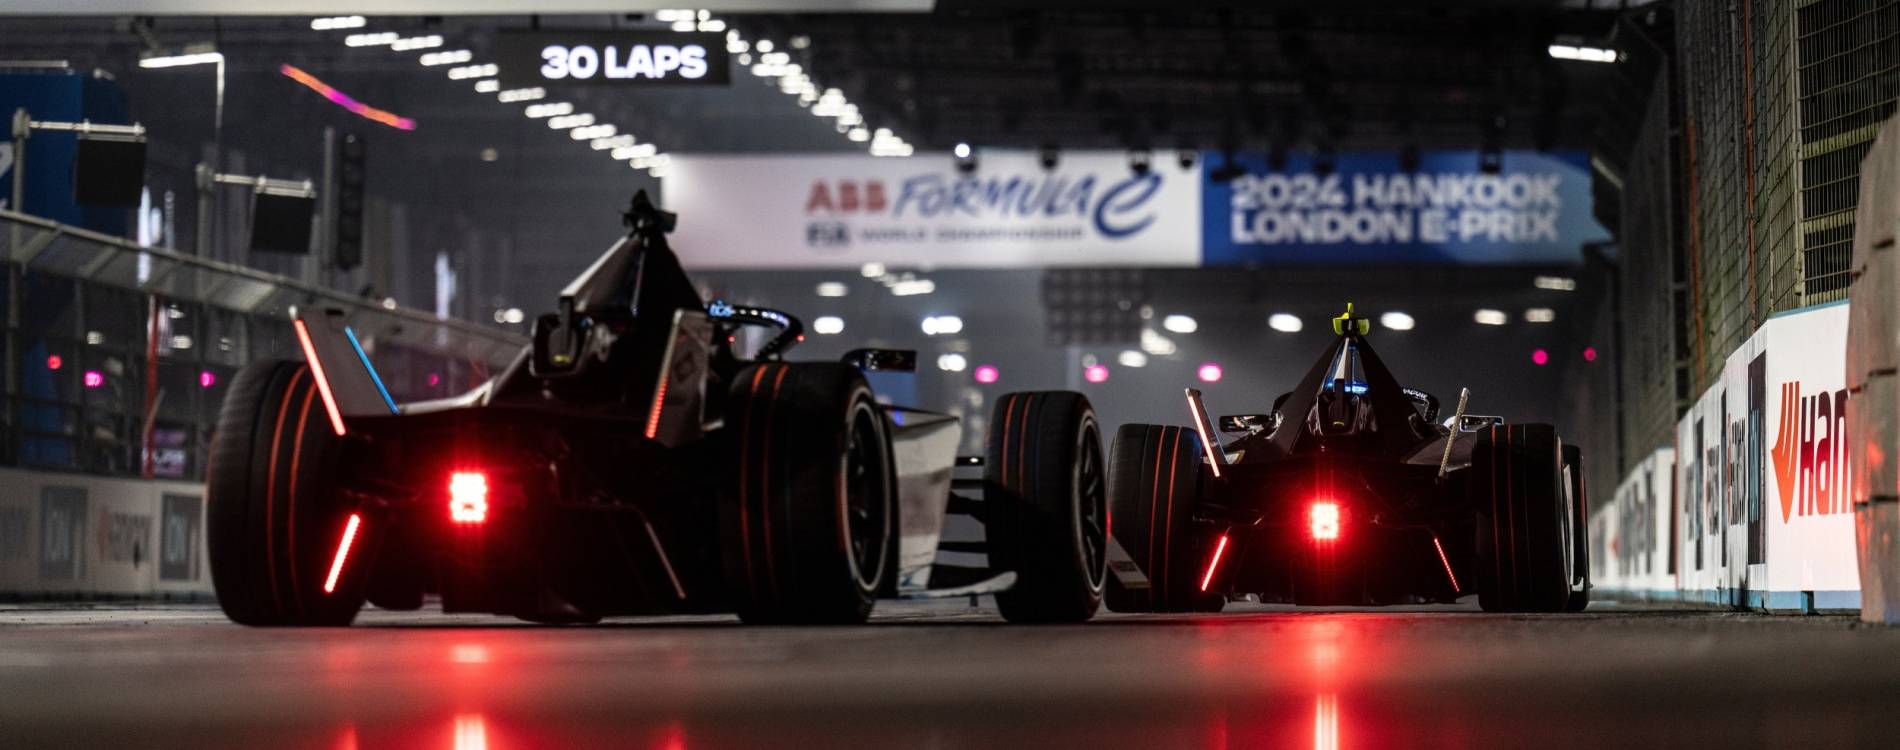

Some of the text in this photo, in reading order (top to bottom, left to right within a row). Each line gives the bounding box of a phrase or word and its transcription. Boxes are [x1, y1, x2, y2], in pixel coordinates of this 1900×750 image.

[541, 45, 708, 79] 30 LAPS
[806, 180, 887, 213] ABB
[892, 173, 1096, 218] FORMULA
[1231, 174, 1561, 207] 2024 HANKOOK
[1231, 209, 1560, 243] LONDON E-PRIX
[1798, 388, 1855, 517] Han
